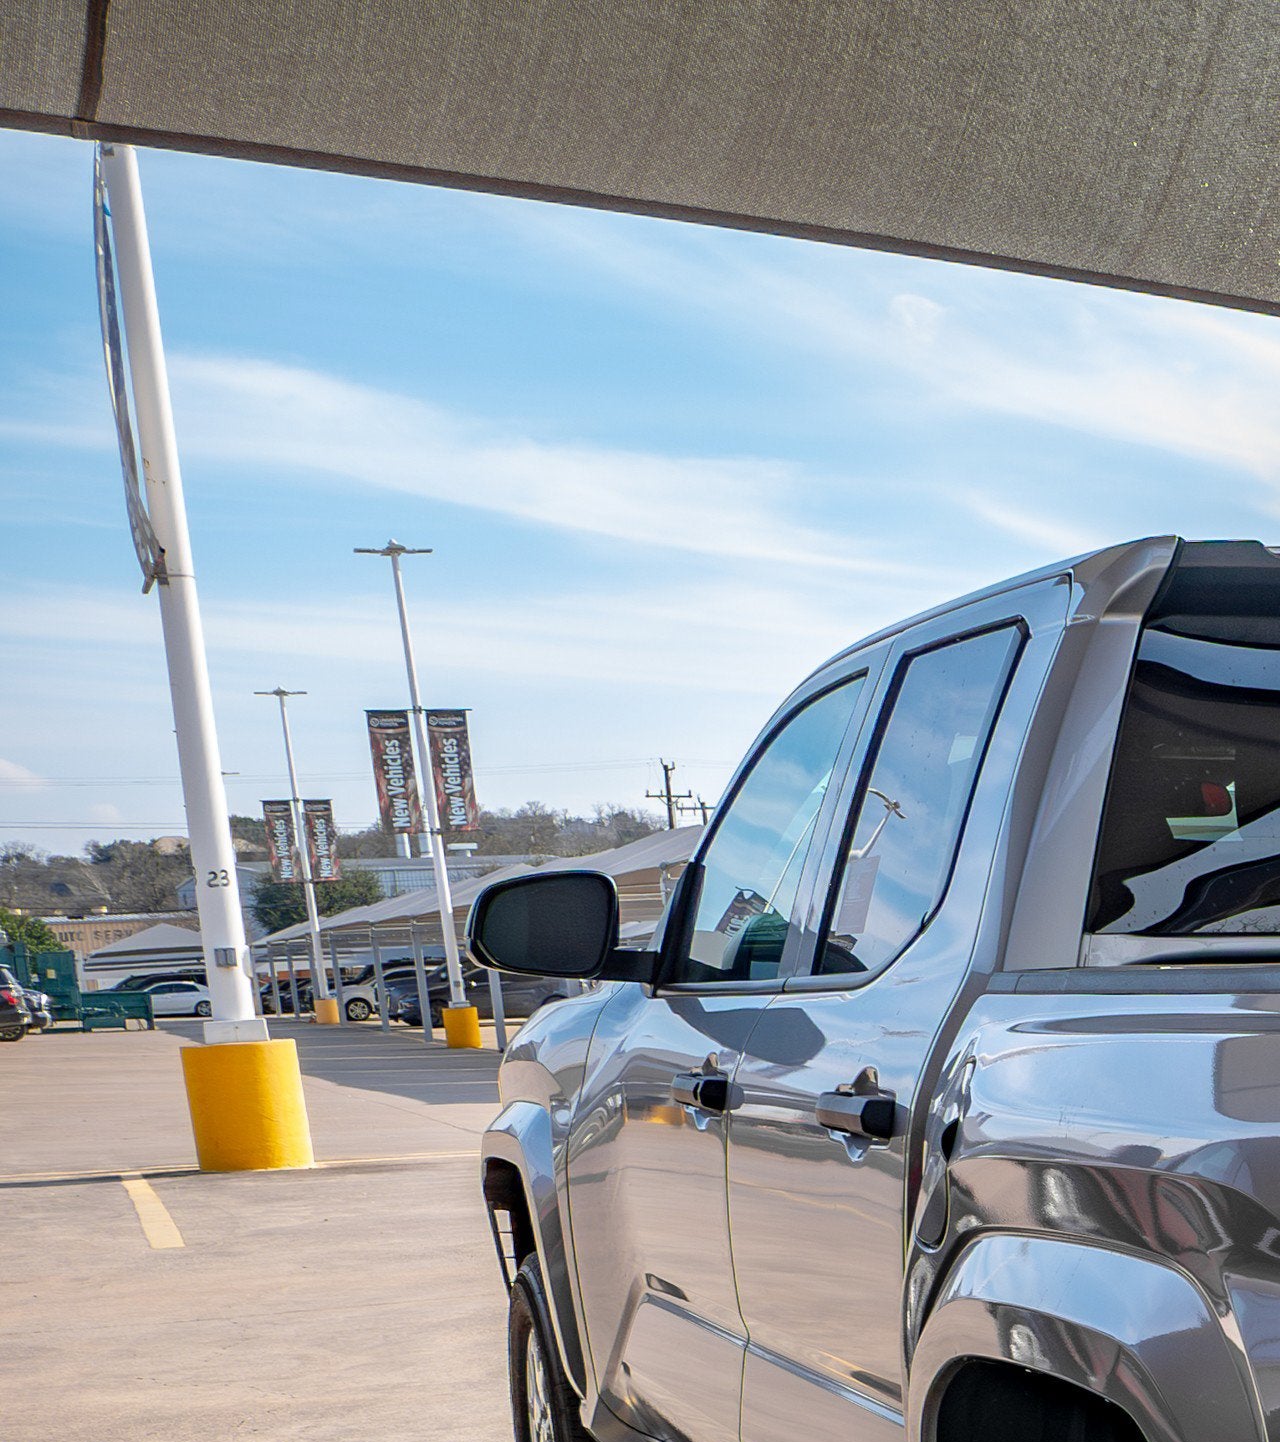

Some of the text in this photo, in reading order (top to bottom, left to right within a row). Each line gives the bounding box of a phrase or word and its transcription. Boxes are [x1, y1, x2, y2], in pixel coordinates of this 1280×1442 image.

[382, 739, 407, 796] Vehicles
[440, 738, 464, 795] Vehicles
[392, 798, 411, 828] New
[449, 796, 468, 826] New
[273, 819, 290, 857] Vehicles
[314, 818, 330, 856] Vehicles
[207, 869, 230, 888] 23
[281, 858, 294, 878] New
[320, 857, 333, 878] New
